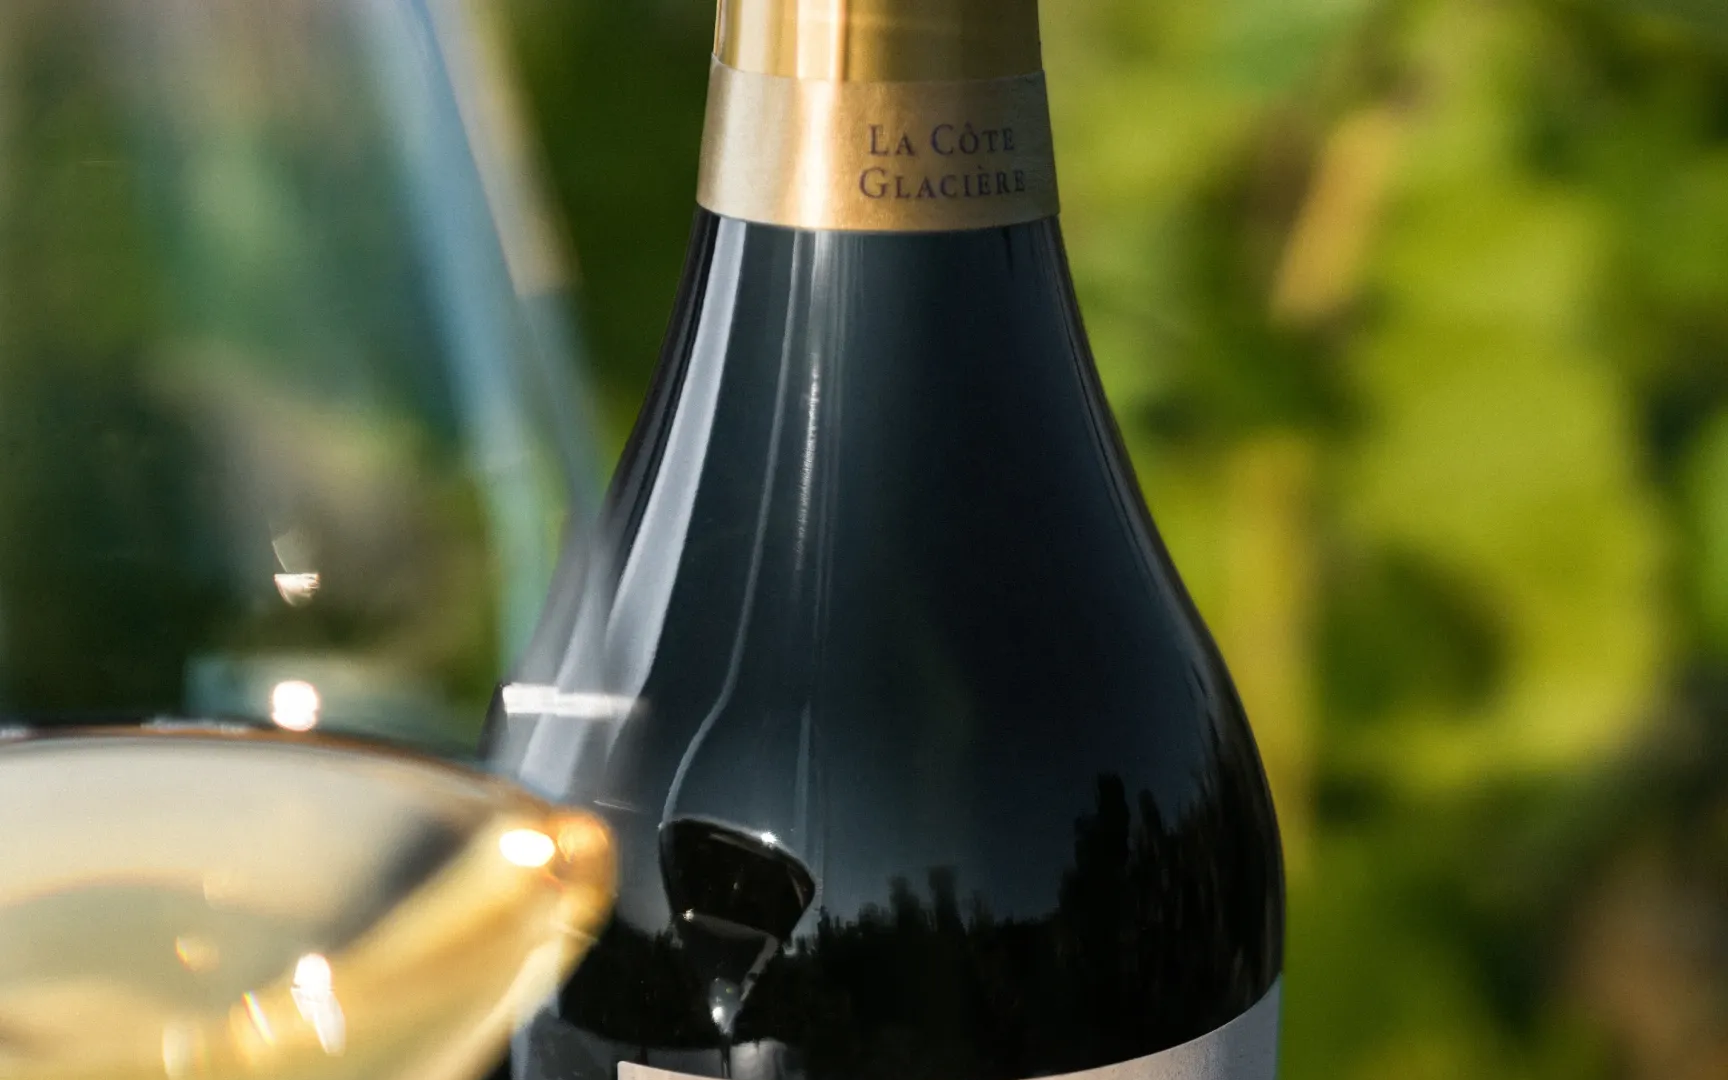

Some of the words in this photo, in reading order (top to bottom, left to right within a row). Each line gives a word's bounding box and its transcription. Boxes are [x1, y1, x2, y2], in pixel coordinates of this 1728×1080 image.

[869, 124, 916, 157] LA
[930, 121, 1016, 153] CÔTE
[858, 166, 1026, 200] GLACIÈRE
